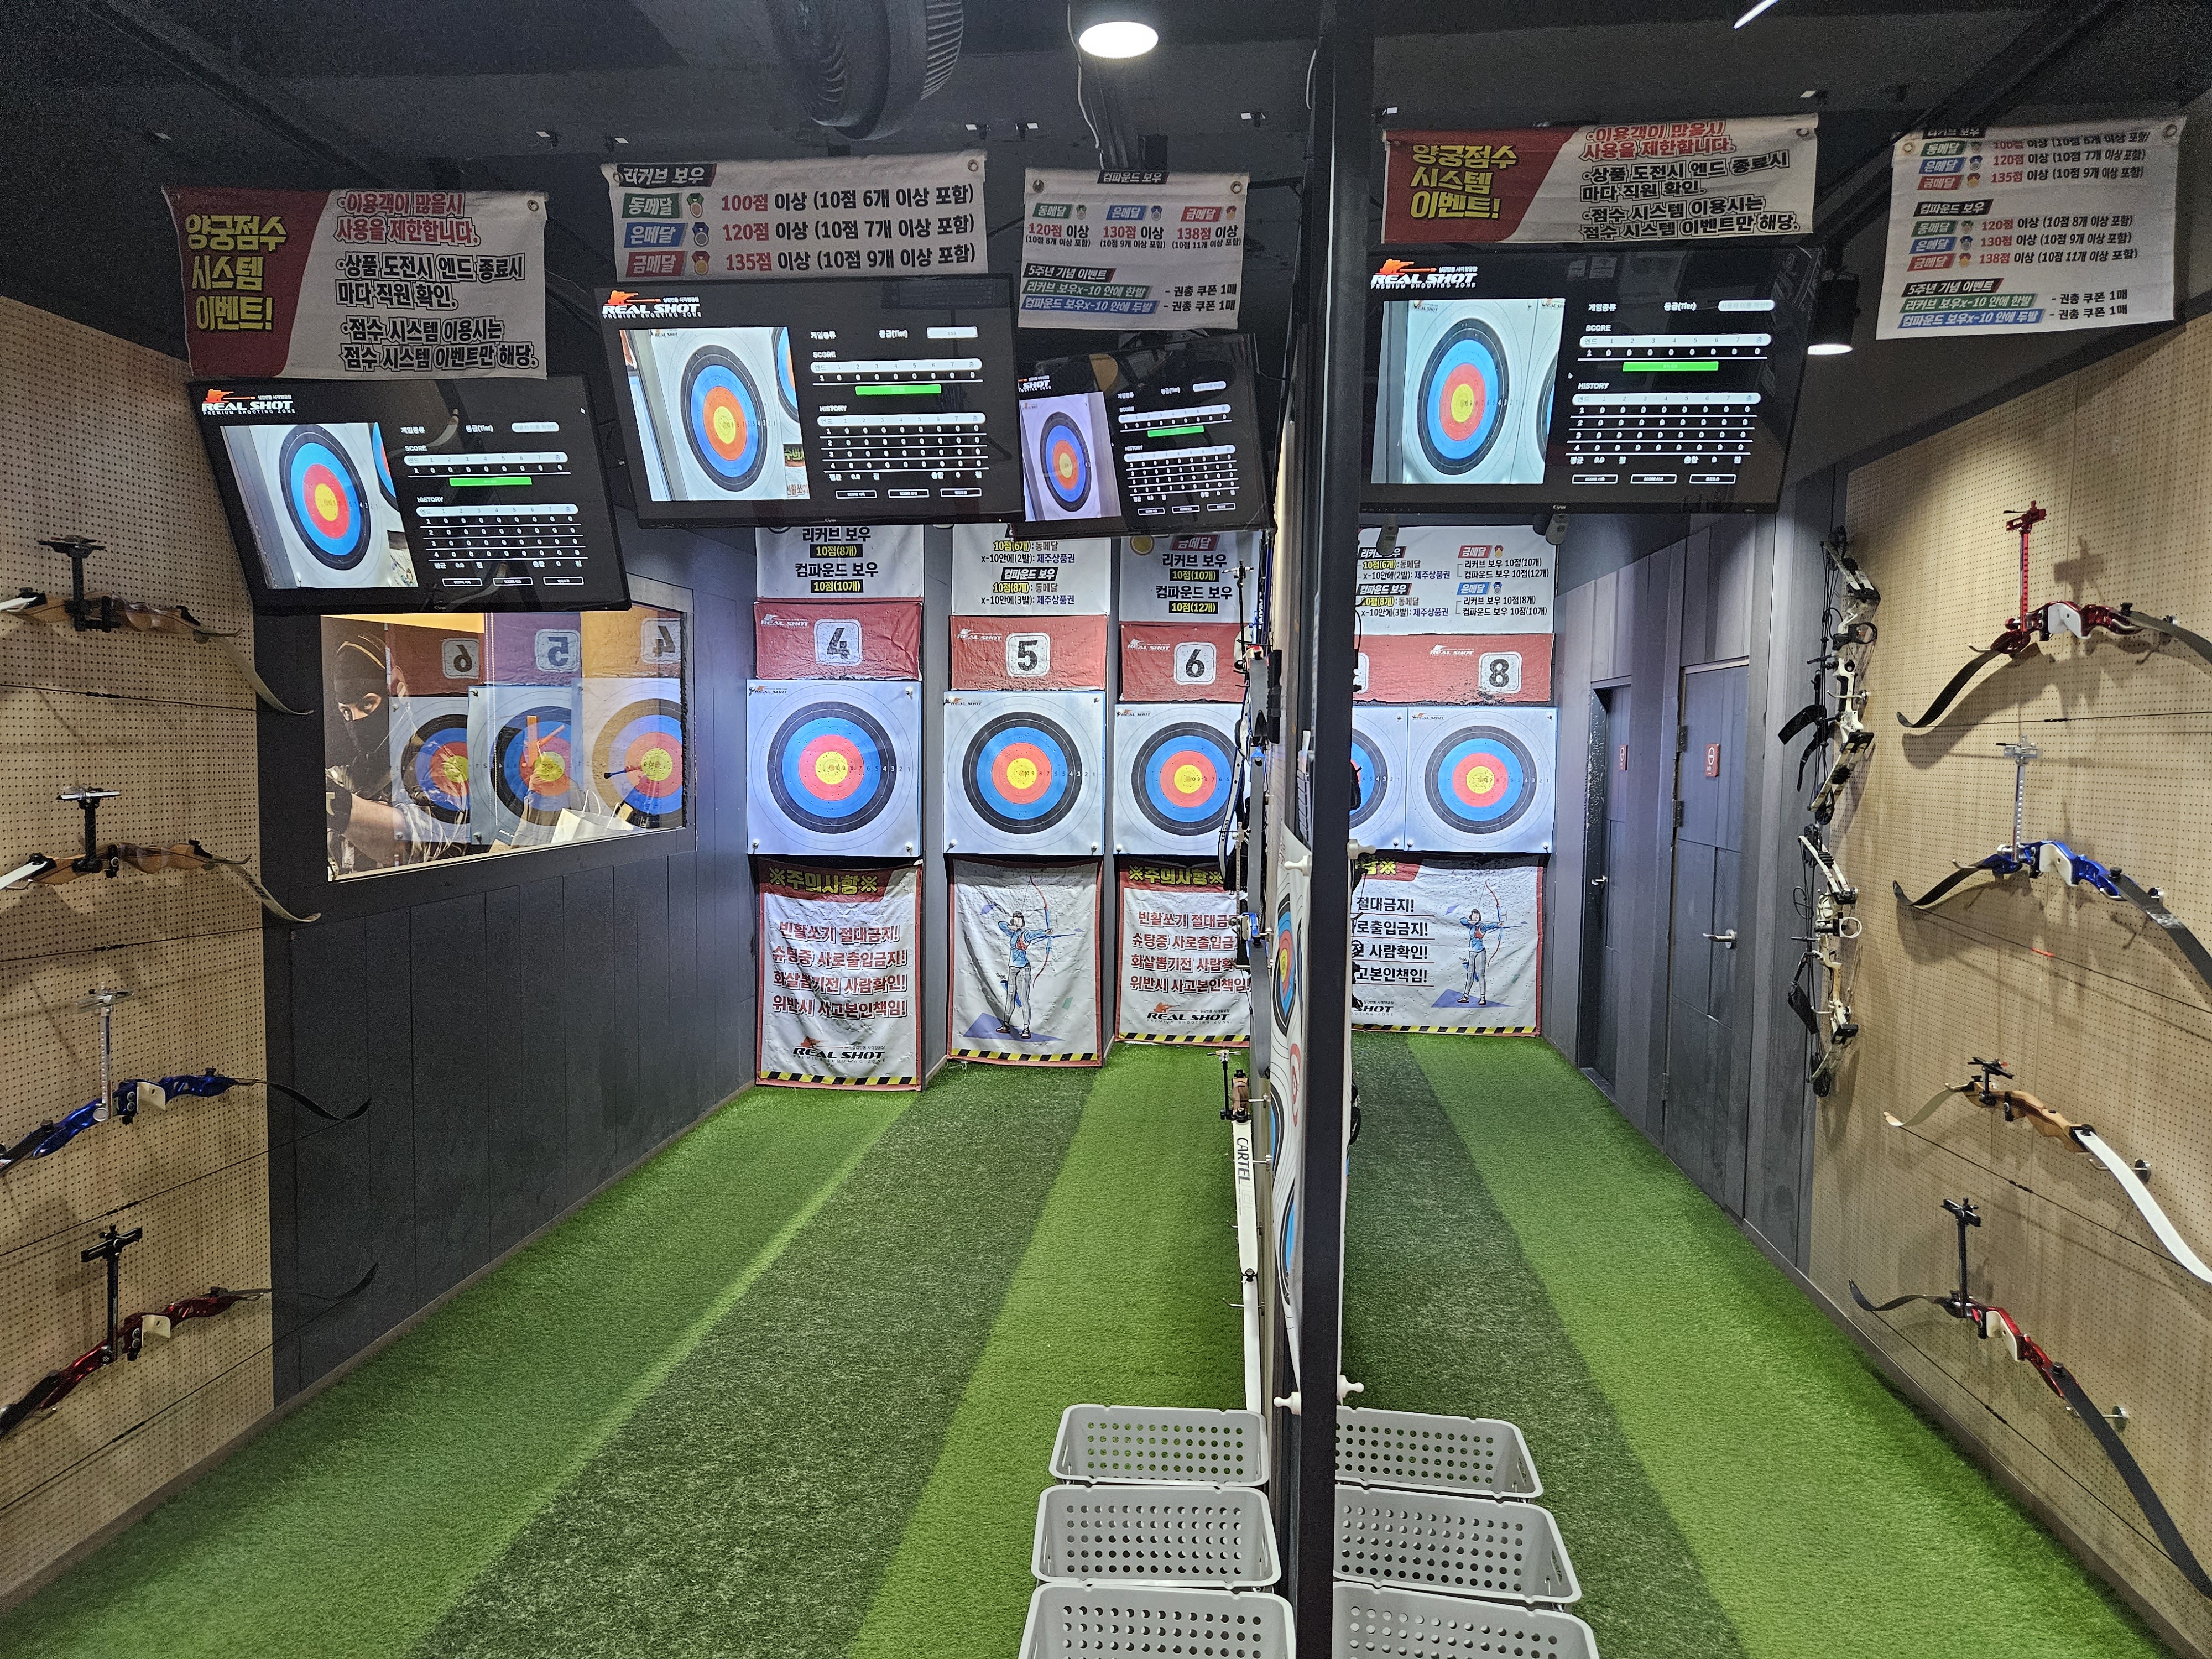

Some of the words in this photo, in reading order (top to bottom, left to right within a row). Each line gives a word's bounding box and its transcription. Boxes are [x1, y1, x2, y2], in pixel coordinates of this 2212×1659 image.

[1672, 122, 1723, 137] 많을시
[1412, 144, 1517, 166] 양궁점수
[1584, 143, 1635, 159] 사용을
[1641, 138, 1734, 155] 제한합니다.
[623, 168, 667, 185] 리커브
[672, 167, 705, 185] 보우
[1104, 173, 1140, 182] 컴파운드
[1142, 173, 1162, 182] 보우
[1410, 166, 1492, 192] 시스템
[414, 194, 464, 214] 많을시
[628, 195, 674, 217] 동메달
[721, 195, 769, 212] 100점
[775, 194, 807, 210] 이상
[813, 191, 857, 209] (10점
[864, 189, 890, 207] 6개
[896, 188, 929, 206] 이상
[936, 185, 974, 205] 포함)
[1410, 192, 1500, 218] 이벤트!
[1921, 204, 1960, 214] 컴파운드
[1964, 202, 1984, 213] 보우
[1038, 206, 1067, 216] 동메달
[1112, 207, 1141, 217] 은메달
[1186, 208, 1216, 219] 금메달
[185, 215, 286, 250] 양궁점수
[337, 220, 385, 243] 사용을
[389, 220, 478, 244] 제한합니다.
[1029, 223, 1062, 237] 120점
[1067, 226, 1089, 238] 이상
[1177, 228, 1211, 239] 138점
[1215, 226, 1238, 238] 이상
[632, 254, 677, 275] 금메달
[727, 252, 772, 271] 135점
[779, 251, 810, 270] 이상
[817, 249, 861, 269] (10점
[867, 248, 894, 267] 9개
[901, 247, 932, 266] 이상
[938, 244, 975, 264] 포함)
[192, 257, 262, 290] 시스템
[383, 256, 433, 279] 도전시
[439, 258, 473, 279] 엔드
[479, 256, 523, 279] 종료시
[1028, 266, 1056, 276] 5주년
[1057, 267, 1077, 278] 기념
[1078, 268, 1107, 279] 이벤트
[1371, 274, 1423, 284] REAL
[1426, 273, 1478, 283] SHOT
[1174, 286, 1193, 296] 권총
[1197, 285, 1217, 296] 쿠폰
[1220, 284, 1237, 295] 1매
[1907, 283, 1936, 294] 5주년
[1938, 282, 1960, 293] 기념
[1963, 280, 1994, 292] 이벤트
[339, 283, 373, 306] 마다
[377, 283, 411, 306] 직원
[416, 284, 457, 308] 확인.
[2060, 294, 2079, 304] 권총
[2083, 292, 2105, 303] 쿠폰
[2110, 289, 2127, 300] 1매
[197, 296, 273, 330] 이벤트!
[602, 305, 650, 314] REAL
[653, 304, 700, 313] SHOT
[344, 347, 379, 369] 점수
[383, 346, 432, 369] 시스템
[436, 346, 495, 366] 이벤트만
[499, 344, 537, 366] 해당.
[250, 401, 293, 410] SHOT
[802, 528, 841, 542] 리커브
[846, 527, 871, 541] 보우
[816, 546, 857, 556] 10점(8개)
[1035, 541, 1058, 551] 동메달
[1463, 548, 1486, 557] 금메달
[1037, 554, 1075, 563] 제주상품권
[1162, 554, 1198, 567] 리커브
[1202, 554, 1227, 567] 보우
[1489, 560, 1502, 568] 보우
[1505, 559, 1541, 567] 10점(10개)
[795, 563, 848, 577] 컴파운드
[852, 562, 878, 577] 보우
[1004, 570, 1037, 579] 컴파운드
[1039, 569, 1056, 579] 보우
[1172, 571, 1216, 580] 10점(10개)
[1415, 571, 1450, 580] 제주상품권
[1464, 571, 1493, 579] 컴파운드
[1512, 569, 1549, 578] 10점(12개)
[814, 582, 860, 592] 10점(10개)
[1156, 586, 1204, 599] 컴파운드
[1208, 586, 1233, 599] 보우
[1460, 585, 1485, 594] 은메달
[1486, 596, 1500, 604] 보우
[1503, 596, 1536, 604] 10점(8개)
[1172, 603, 1215, 612] 10점(12개)
[827, 628, 849, 659] 4
[1018, 640, 1037, 671] 5
[1186, 649, 1205, 677] 6
[1489, 659, 1509, 687] 8
[780, 922, 835, 938] 빈활쏘기
[839, 927, 899, 942] 절대금지!
[773, 946, 814, 964] 슈팅중
[818, 950, 906, 968] 사로출입금지!
[1369, 945, 1428, 959] 사람확인!
[844, 975, 906, 994] 사람확인!
[773, 995, 814, 1015] 위반시
[819, 1001, 906, 1018] 사고본인책임!
[793, 1047, 838, 1058] REAL
[1237, 1137, 1250, 1185] CARTEL
